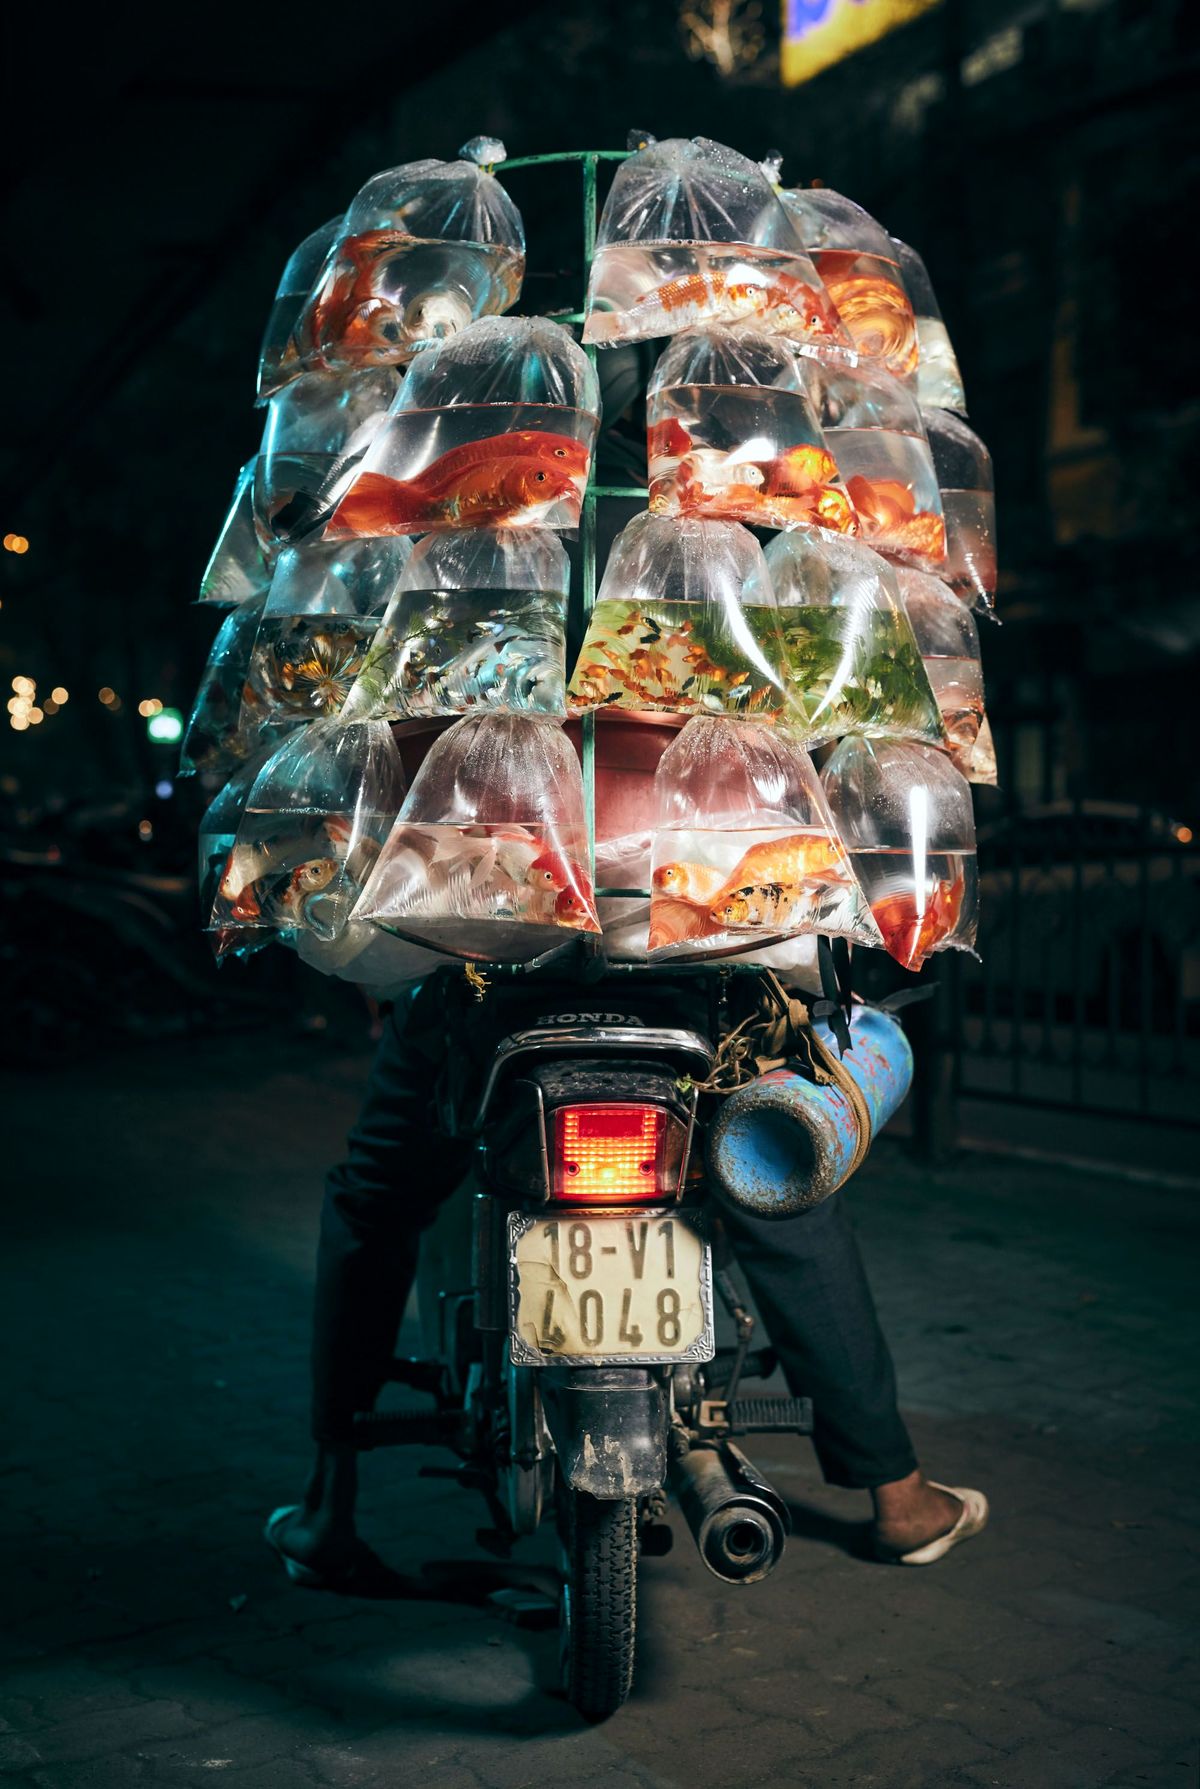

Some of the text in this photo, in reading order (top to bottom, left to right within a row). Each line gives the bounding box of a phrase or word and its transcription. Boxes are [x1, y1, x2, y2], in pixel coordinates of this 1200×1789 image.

[536, 1012, 646, 1027] HONDA
[544, 1221, 675, 1280] 18-V1
[540, 1288, 681, 1347] 4048
